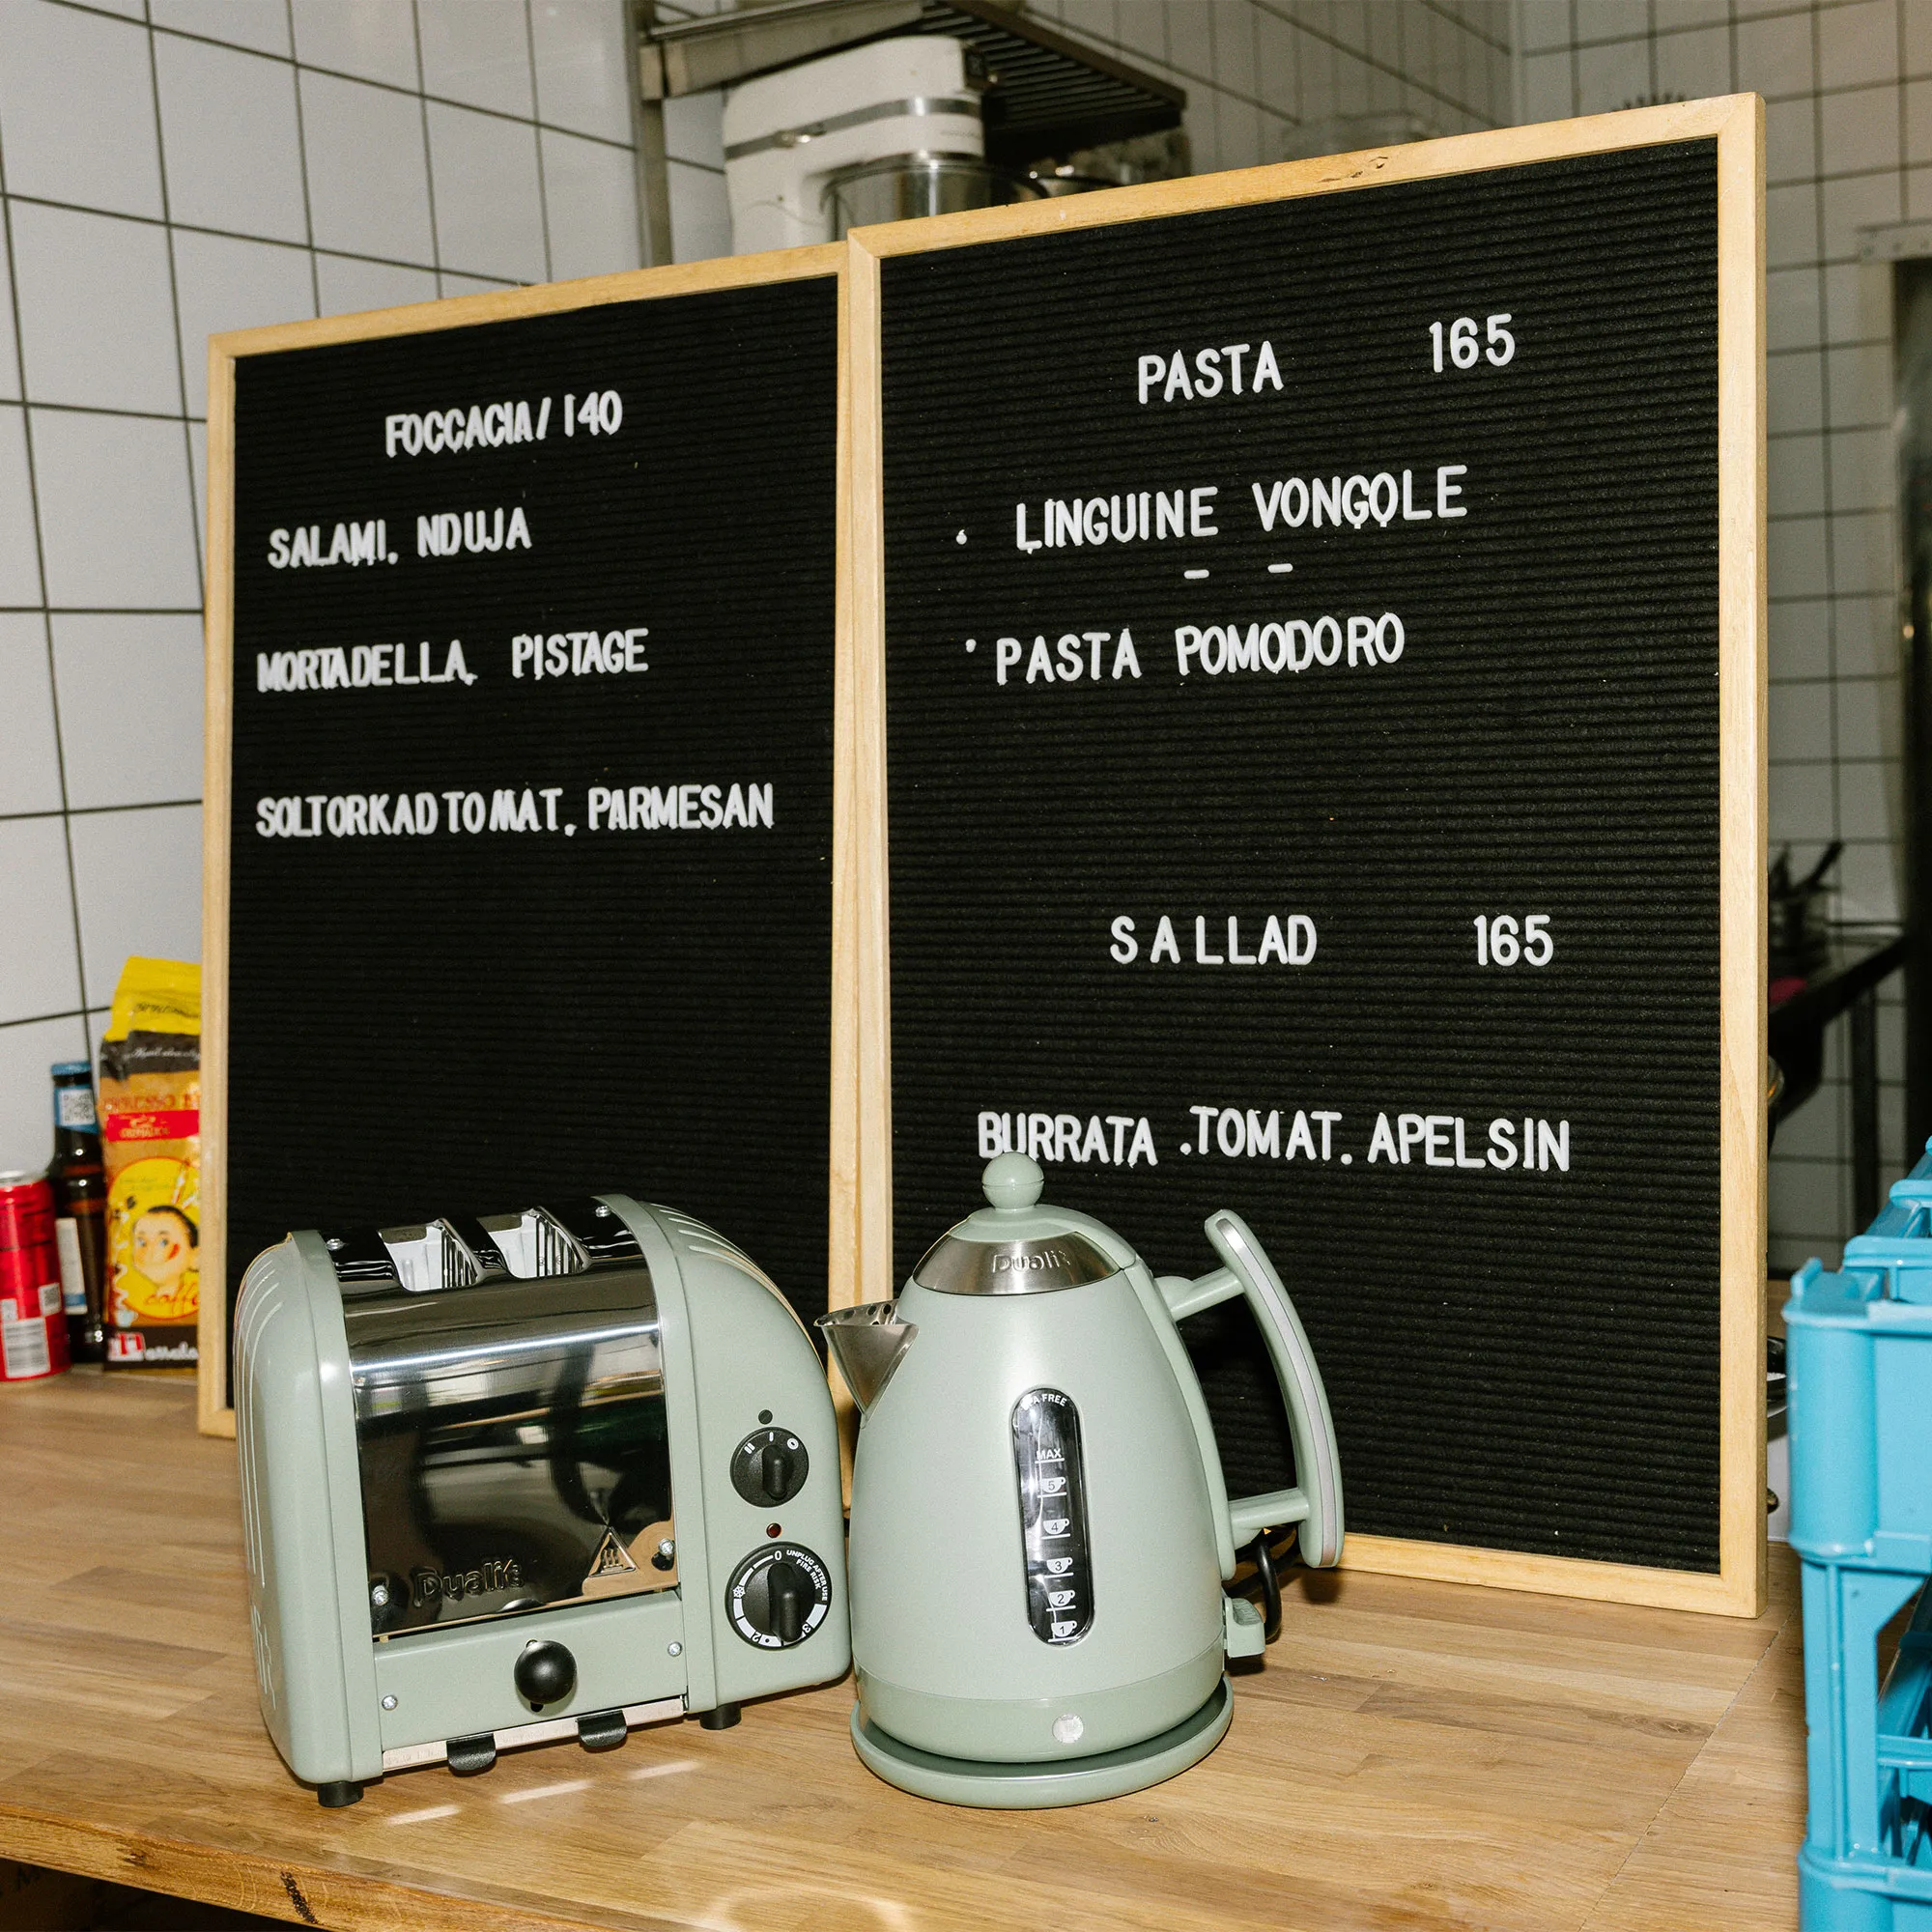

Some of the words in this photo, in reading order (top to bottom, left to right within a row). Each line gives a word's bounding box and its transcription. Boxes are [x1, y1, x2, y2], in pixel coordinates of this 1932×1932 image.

[1138, 340, 1285, 405] PASTA
[1429, 312, 1516, 373] 165
[564, 389, 623, 438] 140
[1016, 486, 1219, 554] LINGUINE
[1251, 464, 1468, 532] VONGOLE
[417, 506, 532, 557] NDUJA
[512, 627, 649, 681] PISTAGE
[996, 627, 1143, 686] PASTA
[1174, 612, 1406, 676] POMODORO
[587, 782, 775, 831] PARMESAN
[1109, 914, 1318, 966] SALLAD
[1473, 914, 1554, 967] 165
[978, 1111, 1158, 1168] BURRATA
[1367, 1112, 1570, 1172] APELSIN
[1041, 1393, 1067, 1407] FREE
[1036, 1447, 1063, 1460] MAX
[1048, 1480, 1056, 1491] 5
[1051, 1521, 1059, 1532] 4
[774, 1550, 782, 1561] 0
[786, 1549, 815, 1566] UNPLUG
[812, 1564, 827, 1586] AFTER
[795, 1558, 812, 1572] FIRE
[810, 1572, 821, 1589] RISK
[1054, 1560, 1063, 1572] 3
[1057, 1593, 1065, 1605] 2
